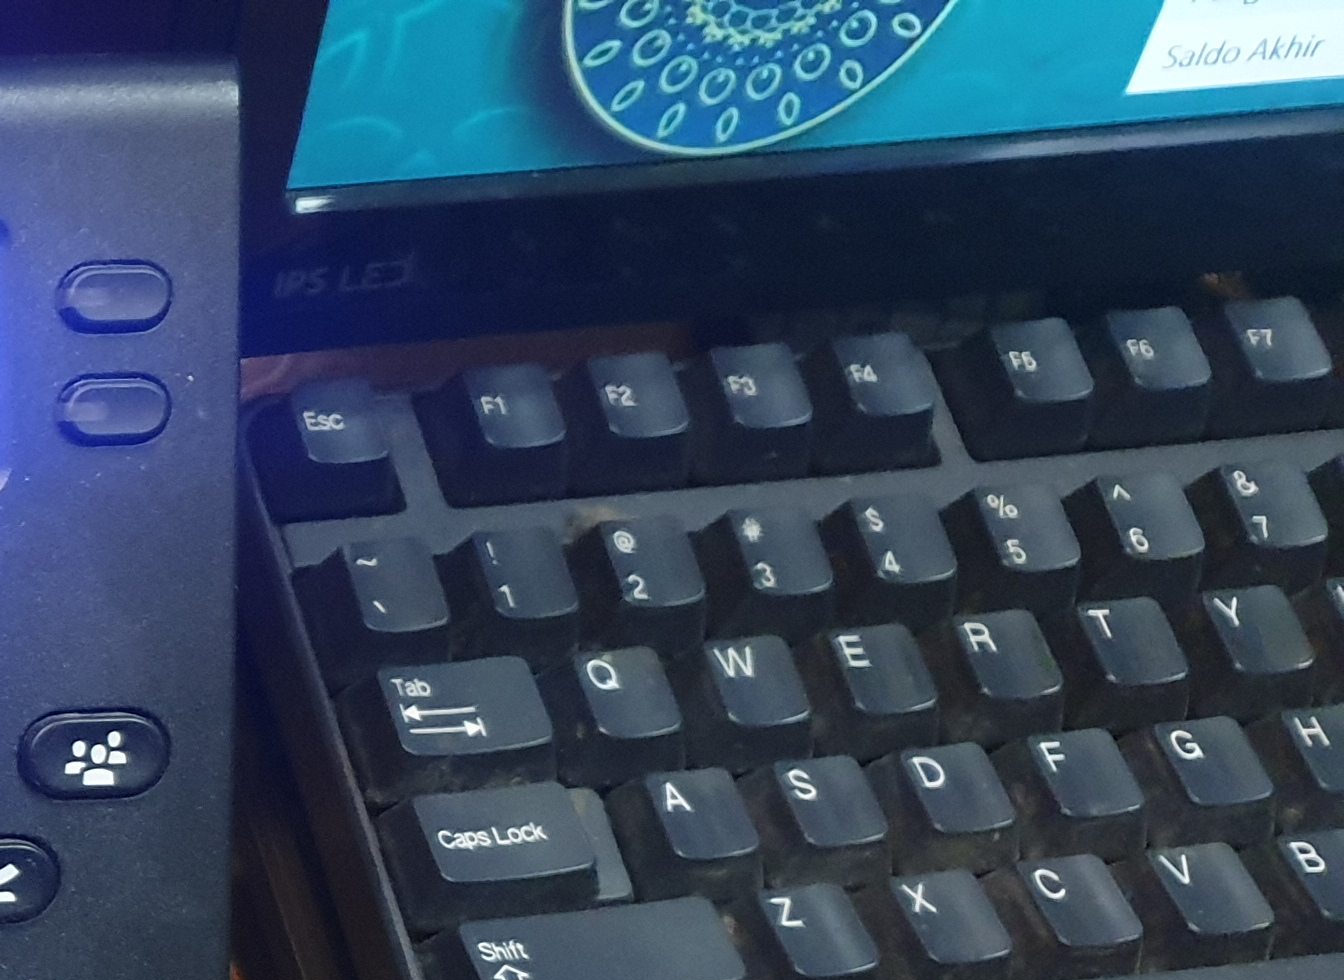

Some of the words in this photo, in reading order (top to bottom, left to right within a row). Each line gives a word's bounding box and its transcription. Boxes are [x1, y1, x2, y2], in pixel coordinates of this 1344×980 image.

[1162, 40, 1241, 69] Saldo
[1246, 34, 1326, 61] Akhir
[1127, 340, 1154, 359] F6
[1248, 329, 1272, 346] F7
[728, 376, 757, 395] F3
[850, 365, 877, 382] F4
[481, 397, 506, 414] F1
[605, 386, 636, 406] F2
[303, 412, 344, 430] Esc
[1130, 528, 1148, 552] 6
[1253, 516, 1268, 538] 7
[885, 551, 900, 573] 4
[1007, 540, 1026, 564] 5
[628, 575, 648, 599] 2
[755, 563, 775, 587] 3
[500, 585, 514, 607] 1
[1088, 610, 1111, 637] T
[1214, 597, 1239, 626] Y
[838, 635, 870, 666] E
[964, 623, 996, 651] R
[587, 660, 619, 689] Q
[714, 647, 753, 677] W
[391, 679, 431, 696] Tab
[1171, 730, 1203, 759] G
[1295, 717, 1329, 745] H
[1040, 742, 1064, 771] F
[788, 769, 816, 800] S
[912, 757, 945, 787] D
[666, 783, 691, 811] A
[438, 824, 490, 850] Caps
[492, 823, 547, 845] Lock
[1160, 855, 1190, 884] V
[1289, 842, 1325, 872] B
[1034, 869, 1065, 899] C
[903, 884, 936, 912] X
[770, 898, 803, 926] Z
[478, 941, 529, 961] Shift
